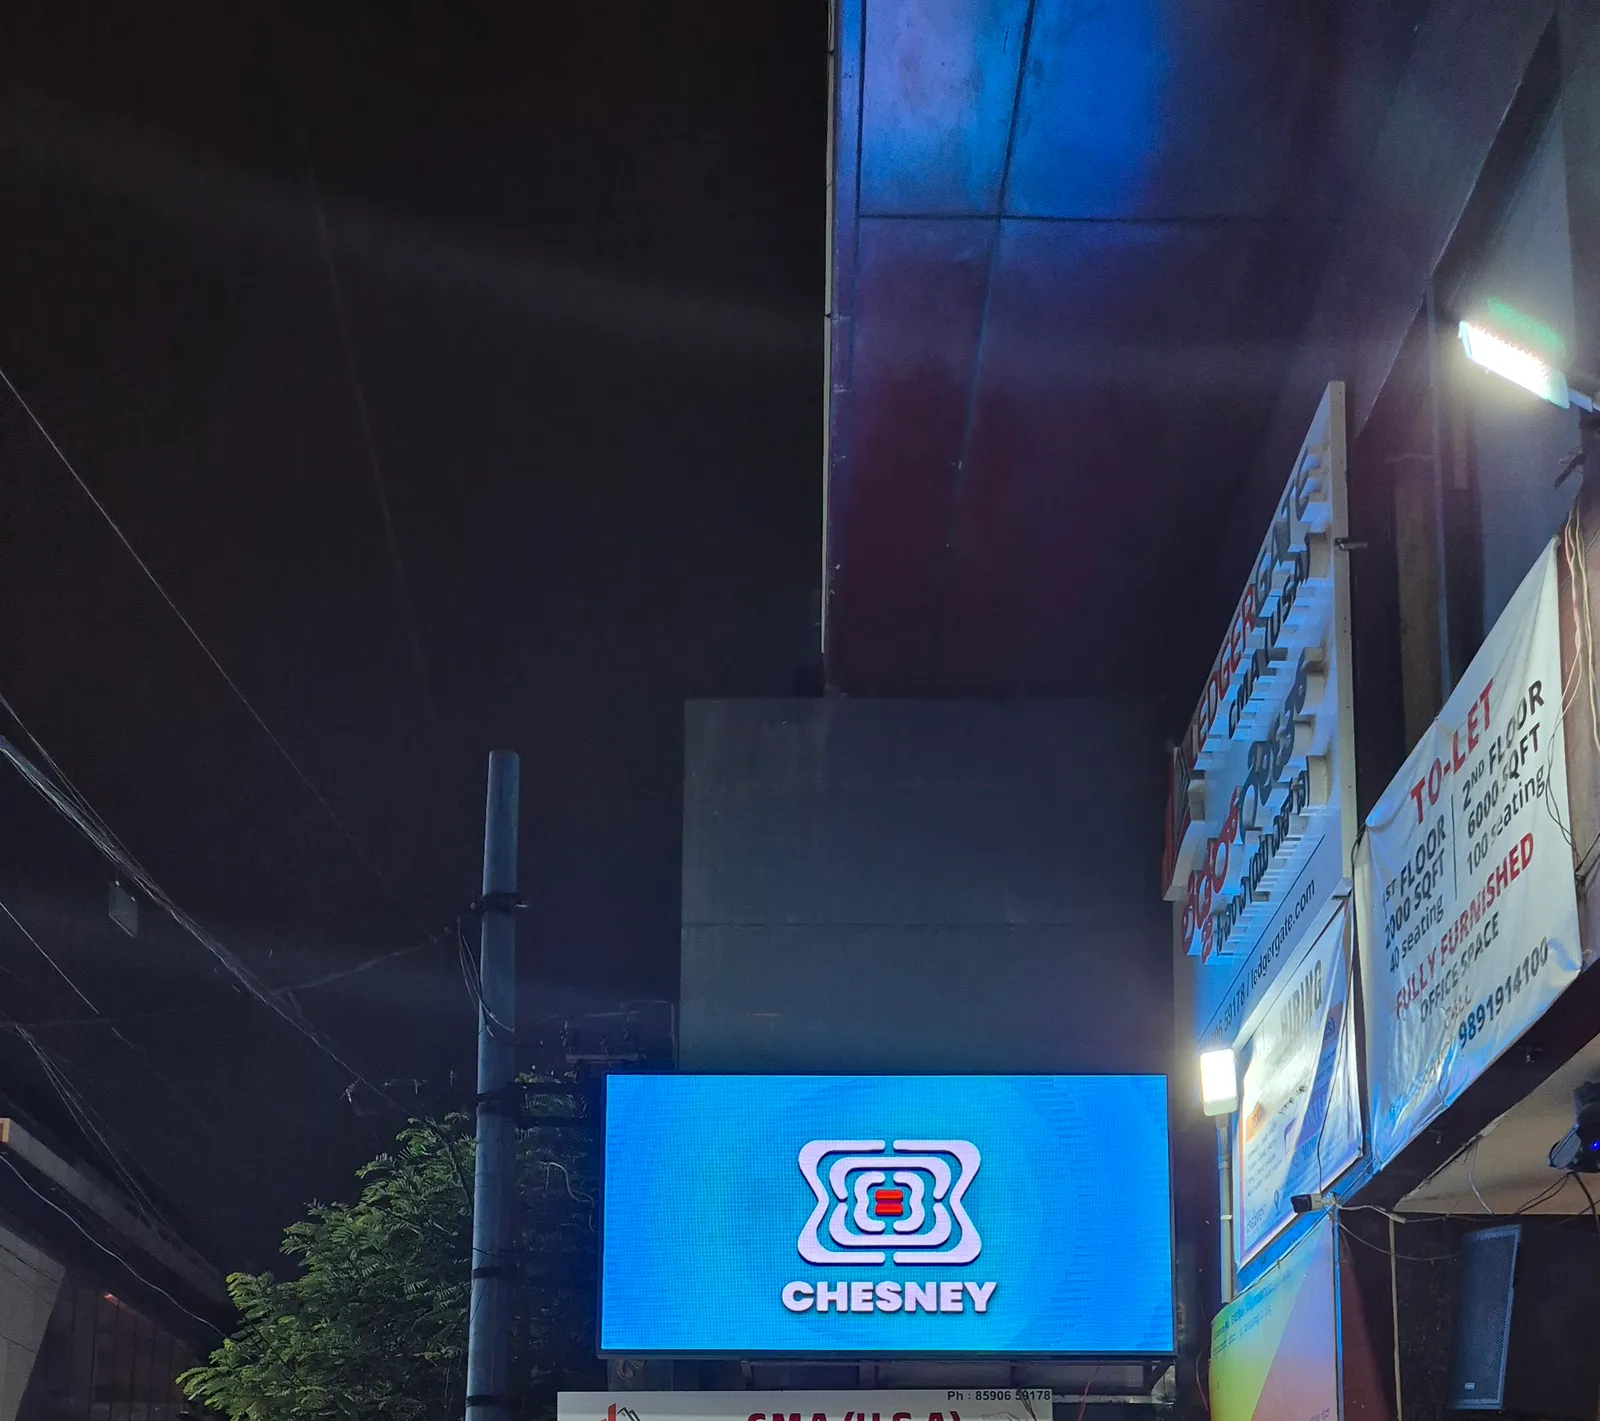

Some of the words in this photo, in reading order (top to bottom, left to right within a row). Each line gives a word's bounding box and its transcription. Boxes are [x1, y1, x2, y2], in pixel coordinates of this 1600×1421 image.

[1229, 650, 1260, 740] CMA
[1410, 677, 1494, 824] TO-LET
[1462, 763, 1485, 812] 2ND
[1489, 680, 1545, 775] FLOOR
[1467, 833, 1489, 876] 100
[1490, 765, 1545, 846] seating
[1468, 779, 1499, 839] 6000
[1502, 722, 1541, 793] SQFT
[1385, 897, 1411, 949] 2000
[1414, 848, 1445, 910] SQFT
[1400, 815, 1447, 897] FLOOR
[1251, 879, 1316, 990] ledgergate.com
[1396, 947, 1437, 1021] FULLY
[1440, 832, 1534, 967] FURNISHED
[1401, 894, 1444, 959] seating
[1420, 967, 1459, 1024] OFFICE
[1460, 911, 1500, 978] SPACE
[1458, 936, 1549, 1050] 9891914100
[782, 1280, 997, 1313] CHESNEY
[947, 1391, 964, 1401] Ph
[975, 1389, 1011, 1401] 85906
[1015, 1389, 1050, 1401] 59178
